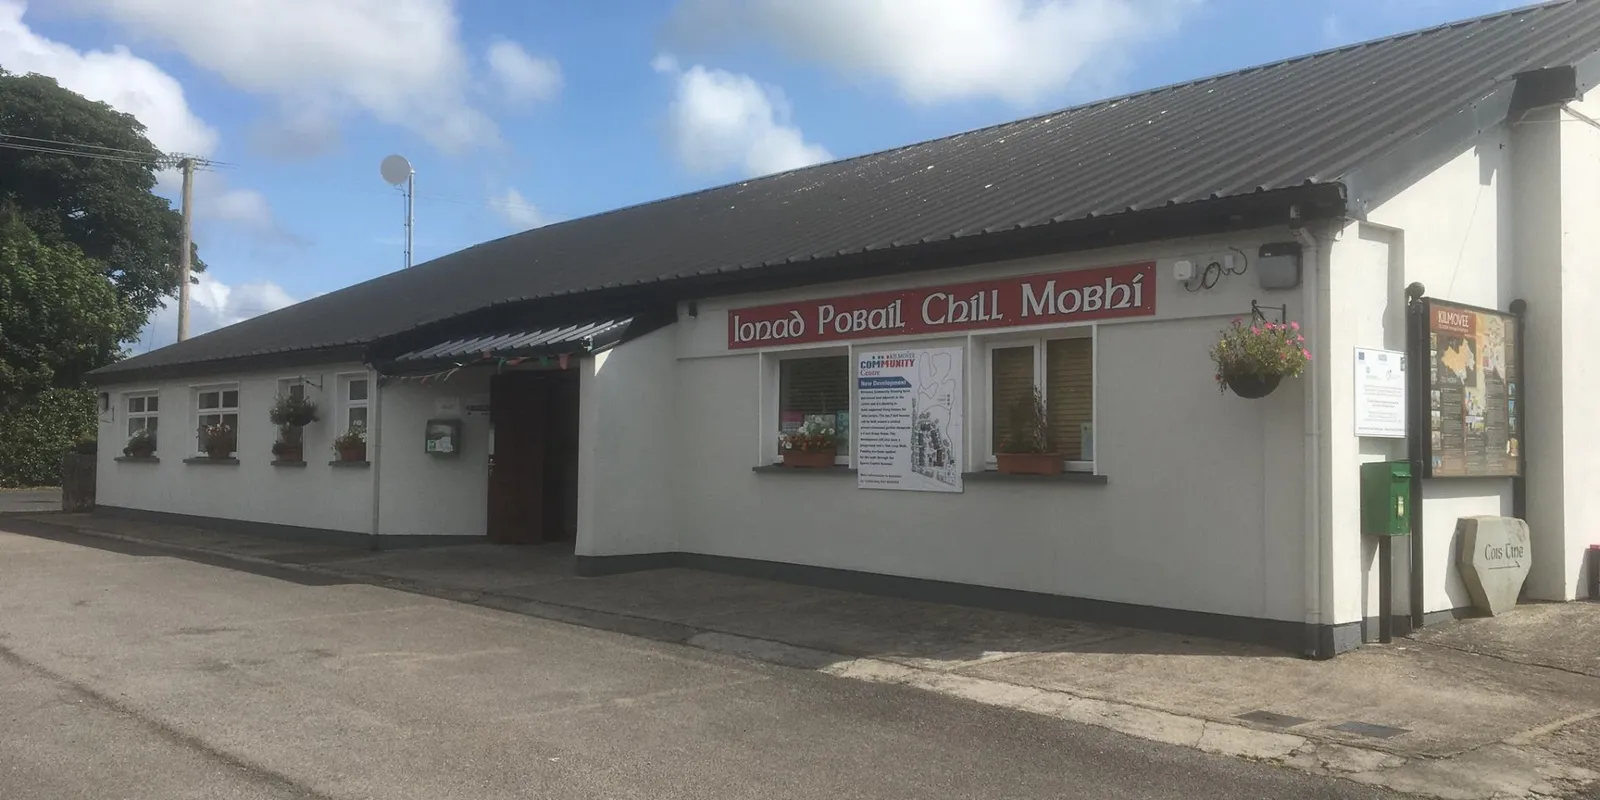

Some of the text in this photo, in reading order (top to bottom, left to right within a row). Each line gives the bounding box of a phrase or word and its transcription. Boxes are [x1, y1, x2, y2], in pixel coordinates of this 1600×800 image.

[1438, 310, 1469, 328] KILMOVEE
[860, 359, 916, 369] COMMUNITY
[1485, 544, 1503, 560] Cois
